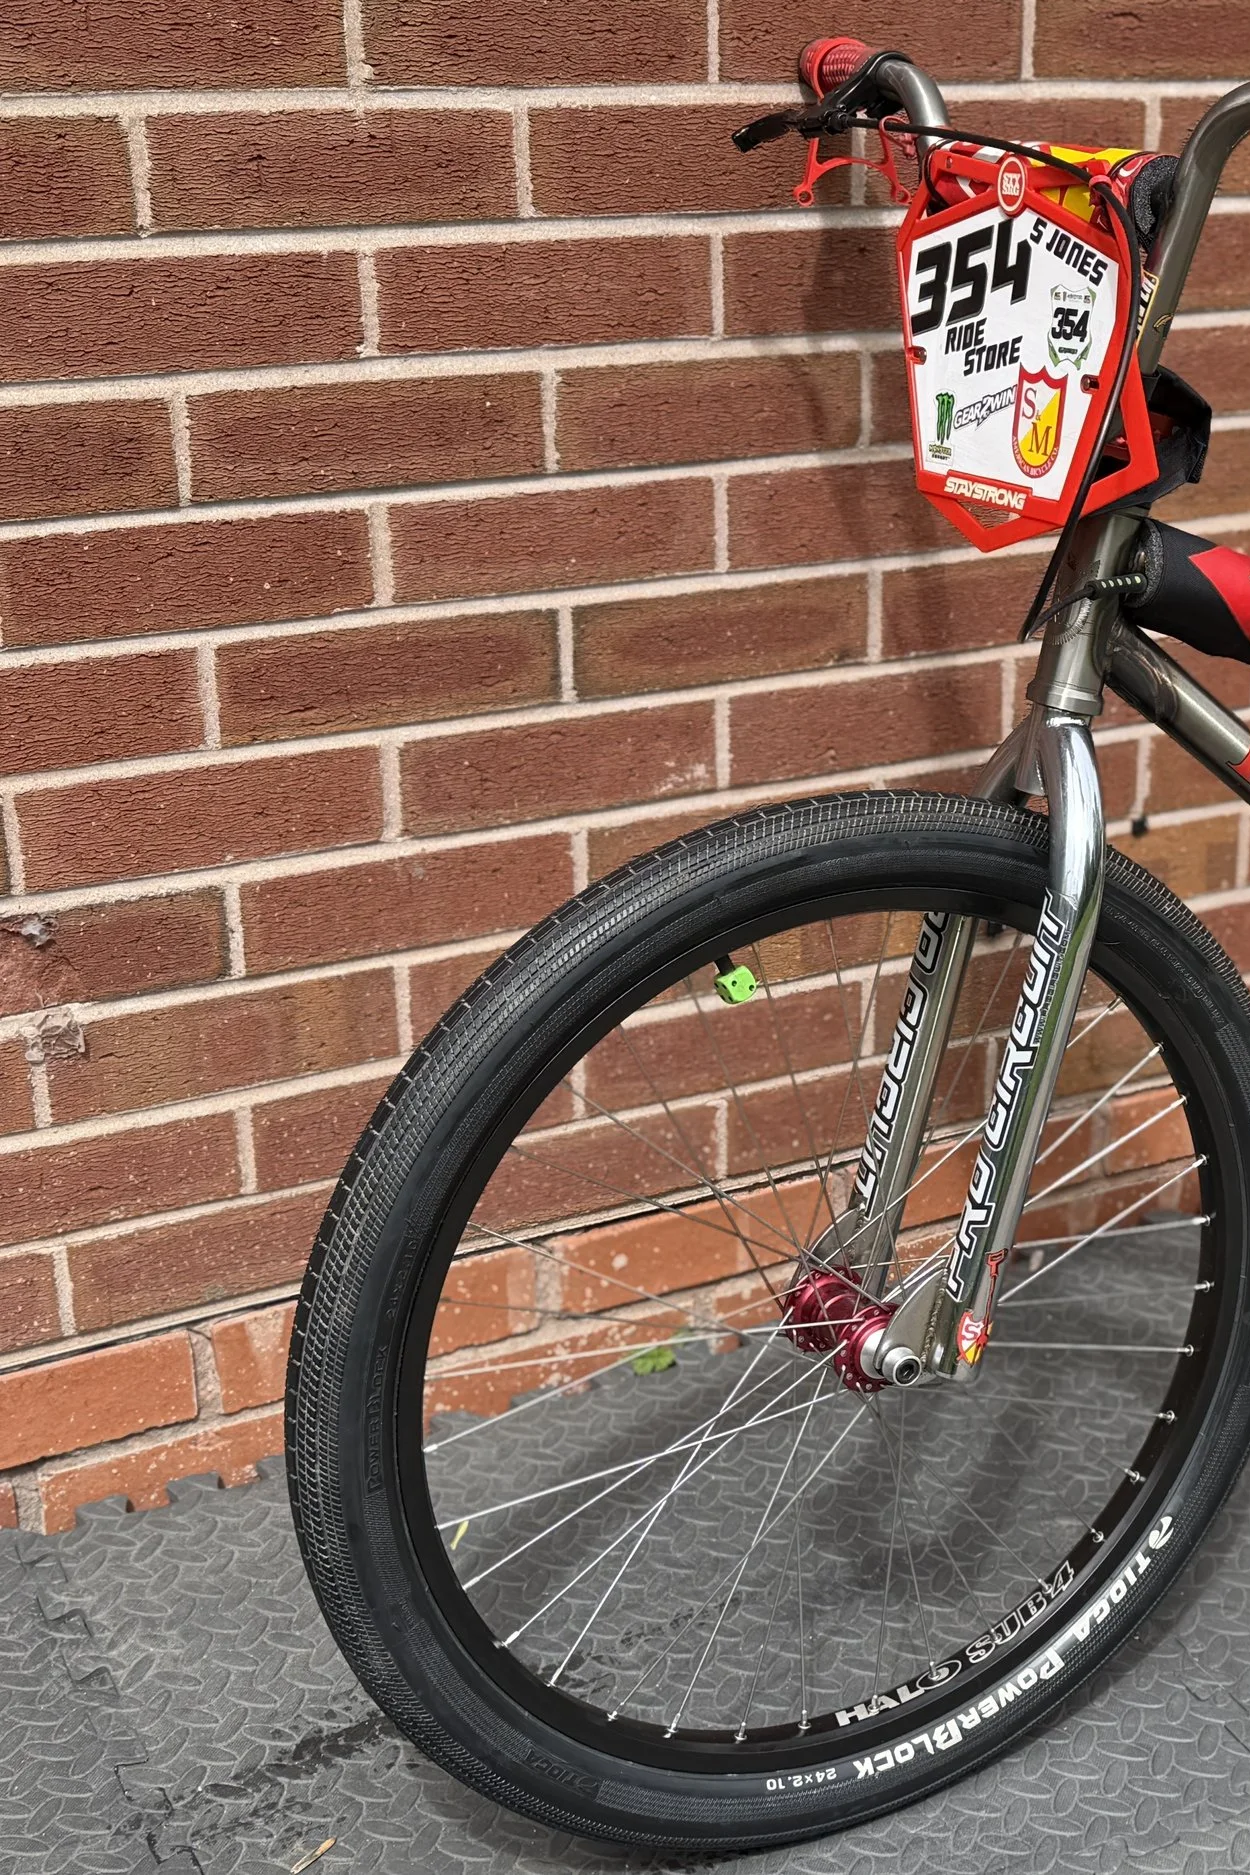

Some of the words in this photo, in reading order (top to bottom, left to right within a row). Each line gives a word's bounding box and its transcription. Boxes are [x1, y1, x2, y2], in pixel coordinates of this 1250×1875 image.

[1029, 217, 1048, 245] S
[1045, 228, 1109, 287] JONES
[911, 218, 1032, 337] 354
[945, 317, 988, 355] RIDE
[1051, 306, 1090, 342] 354
[963, 335, 1023, 377] STORE
[953, 384, 1018, 431] GEAR2WIN
[943, 477, 1028, 510] STAYSTRONG
[946, 1147, 996, 1301] PRO
[985, 887, 1069, 1152] CIRCUIT
[1071, 1550, 1152, 1645] TIOGA
